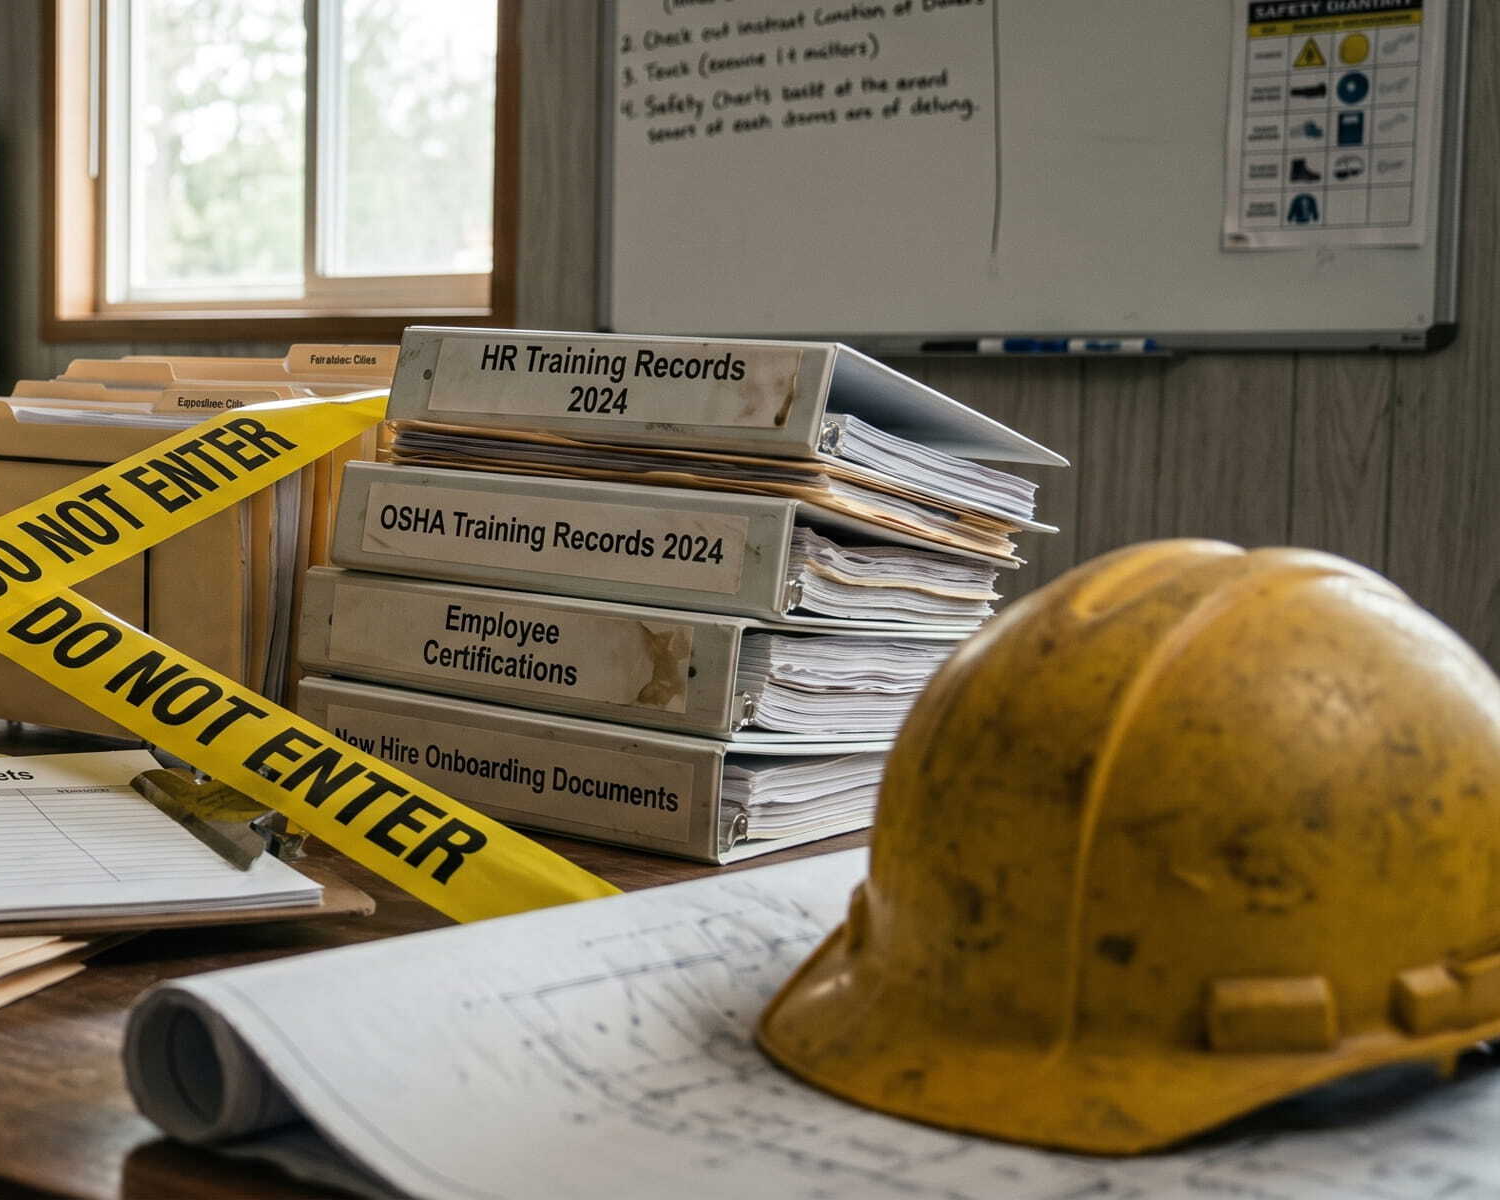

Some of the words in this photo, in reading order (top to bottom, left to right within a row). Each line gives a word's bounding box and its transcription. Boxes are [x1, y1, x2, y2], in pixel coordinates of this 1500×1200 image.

[644, 93, 704, 121] Safety
[480, 344, 517, 372] HR
[526, 346, 627, 383] Training
[634, 349, 746, 381] Records
[567, 386, 628, 415] 2024
[17, 484, 145, 564] NOT
[120, 418, 298, 513] ENTER
[378, 504, 446, 536] OSHA
[453, 512, 545, 551] Training
[553, 522, 655, 557] Records
[662, 532, 724, 565] 2024
[444, 604, 561, 647] Employee
[423, 639, 578, 687] Certifications
[7, 596, 122, 669] DO
[104, 651, 269, 746] NOT
[242, 727, 487, 885] ENTER
[380, 735, 420, 764] Hire
[425, 744, 546, 794] Onboarding
[552, 767, 679, 813] Documents
